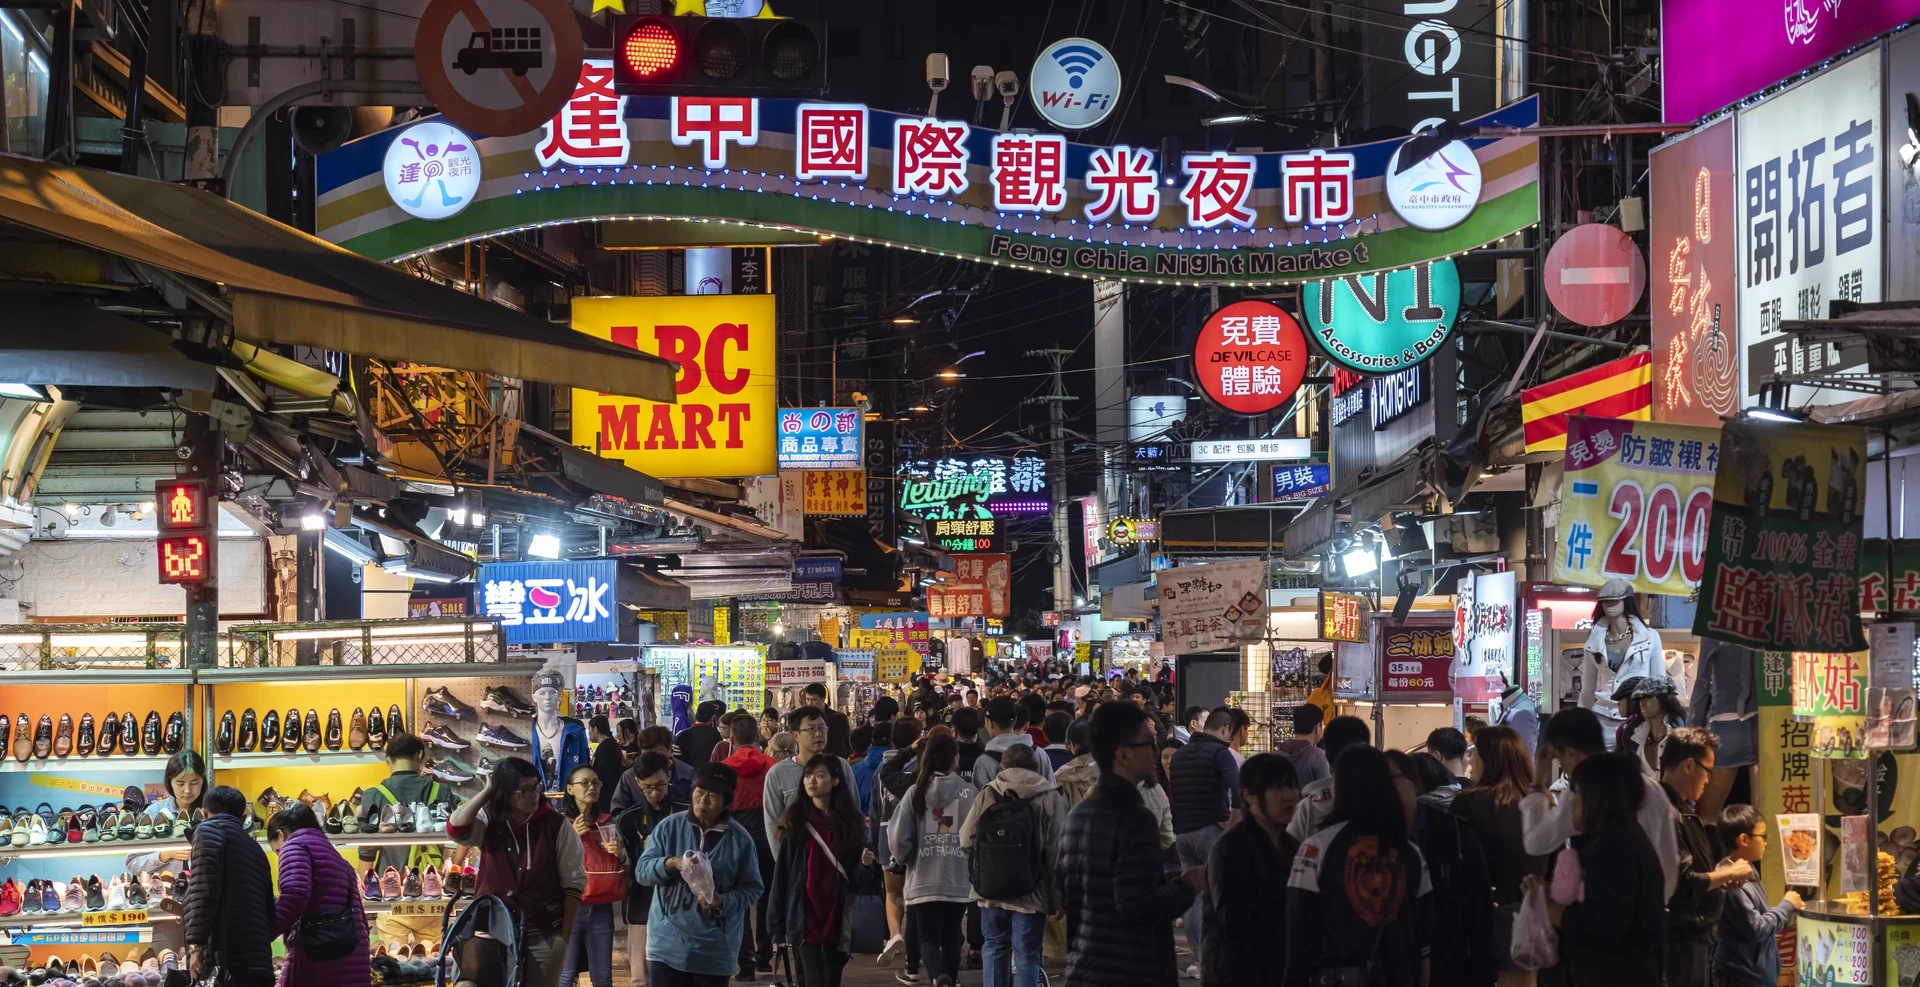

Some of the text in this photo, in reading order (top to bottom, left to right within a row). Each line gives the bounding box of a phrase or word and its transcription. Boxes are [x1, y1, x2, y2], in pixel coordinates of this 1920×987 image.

[1040, 89, 1112, 112] Wi-Fi
[540, 62, 1353, 223] 逢甲國際觀光夜市
[1747, 119, 1874, 289] 開拓者
[990, 235, 1370, 276] Feng Chia Night Market
[1761, 297, 1781, 335] 西服
[1221, 315, 1281, 346] 免費
[1210, 350, 1292, 363] DEVILCASE
[1320, 323, 1447, 368] Accessories & Bags
[1221, 365, 1281, 396] 體驗
[598, 403, 751, 451] MART
[782, 436, 858, 453] 商品專賣
[1198, 446, 1208, 454] 3C
[1213, 445, 1232, 454] 配件
[1237, 444, 1256, 453] 包膜
[1260, 443, 1279, 453] 維修
[1570, 429, 1617, 465] 免燙
[806, 471, 864, 499] 紫雲神算
[901, 470, 992, 509] Leading
[1275, 466, 1315, 492] 男裝
[1293, 491, 1306, 499] BIG
[1307, 486, 1323, 495] SIZE
[936, 520, 994, 536] 肩頸舒壓
[1602, 480, 1714, 588] 200
[1723, 515, 1747, 562] 逢甲
[165, 538, 202, 577] 62
[1751, 530, 1857, 570] 100% 全素
[957, 559, 983, 580] 按摩
[442, 602, 464, 613] SALE
[930, 593, 984, 616] 肩頸舒壓
[1707, 562, 1857, 648] 鹽酥菇
[1388, 677, 1435, 688] 每份60元
[1765, 651, 1784, 695] 逢甲
[920, 844, 963, 858] NOT FADING
[924, 833, 951, 845] SPIRIT
[1852, 927, 1868, 939] 100
[1852, 941, 1868, 954] 100
[1852, 956, 1868, 968] 200
[1853, 970, 1868, 982] 50
